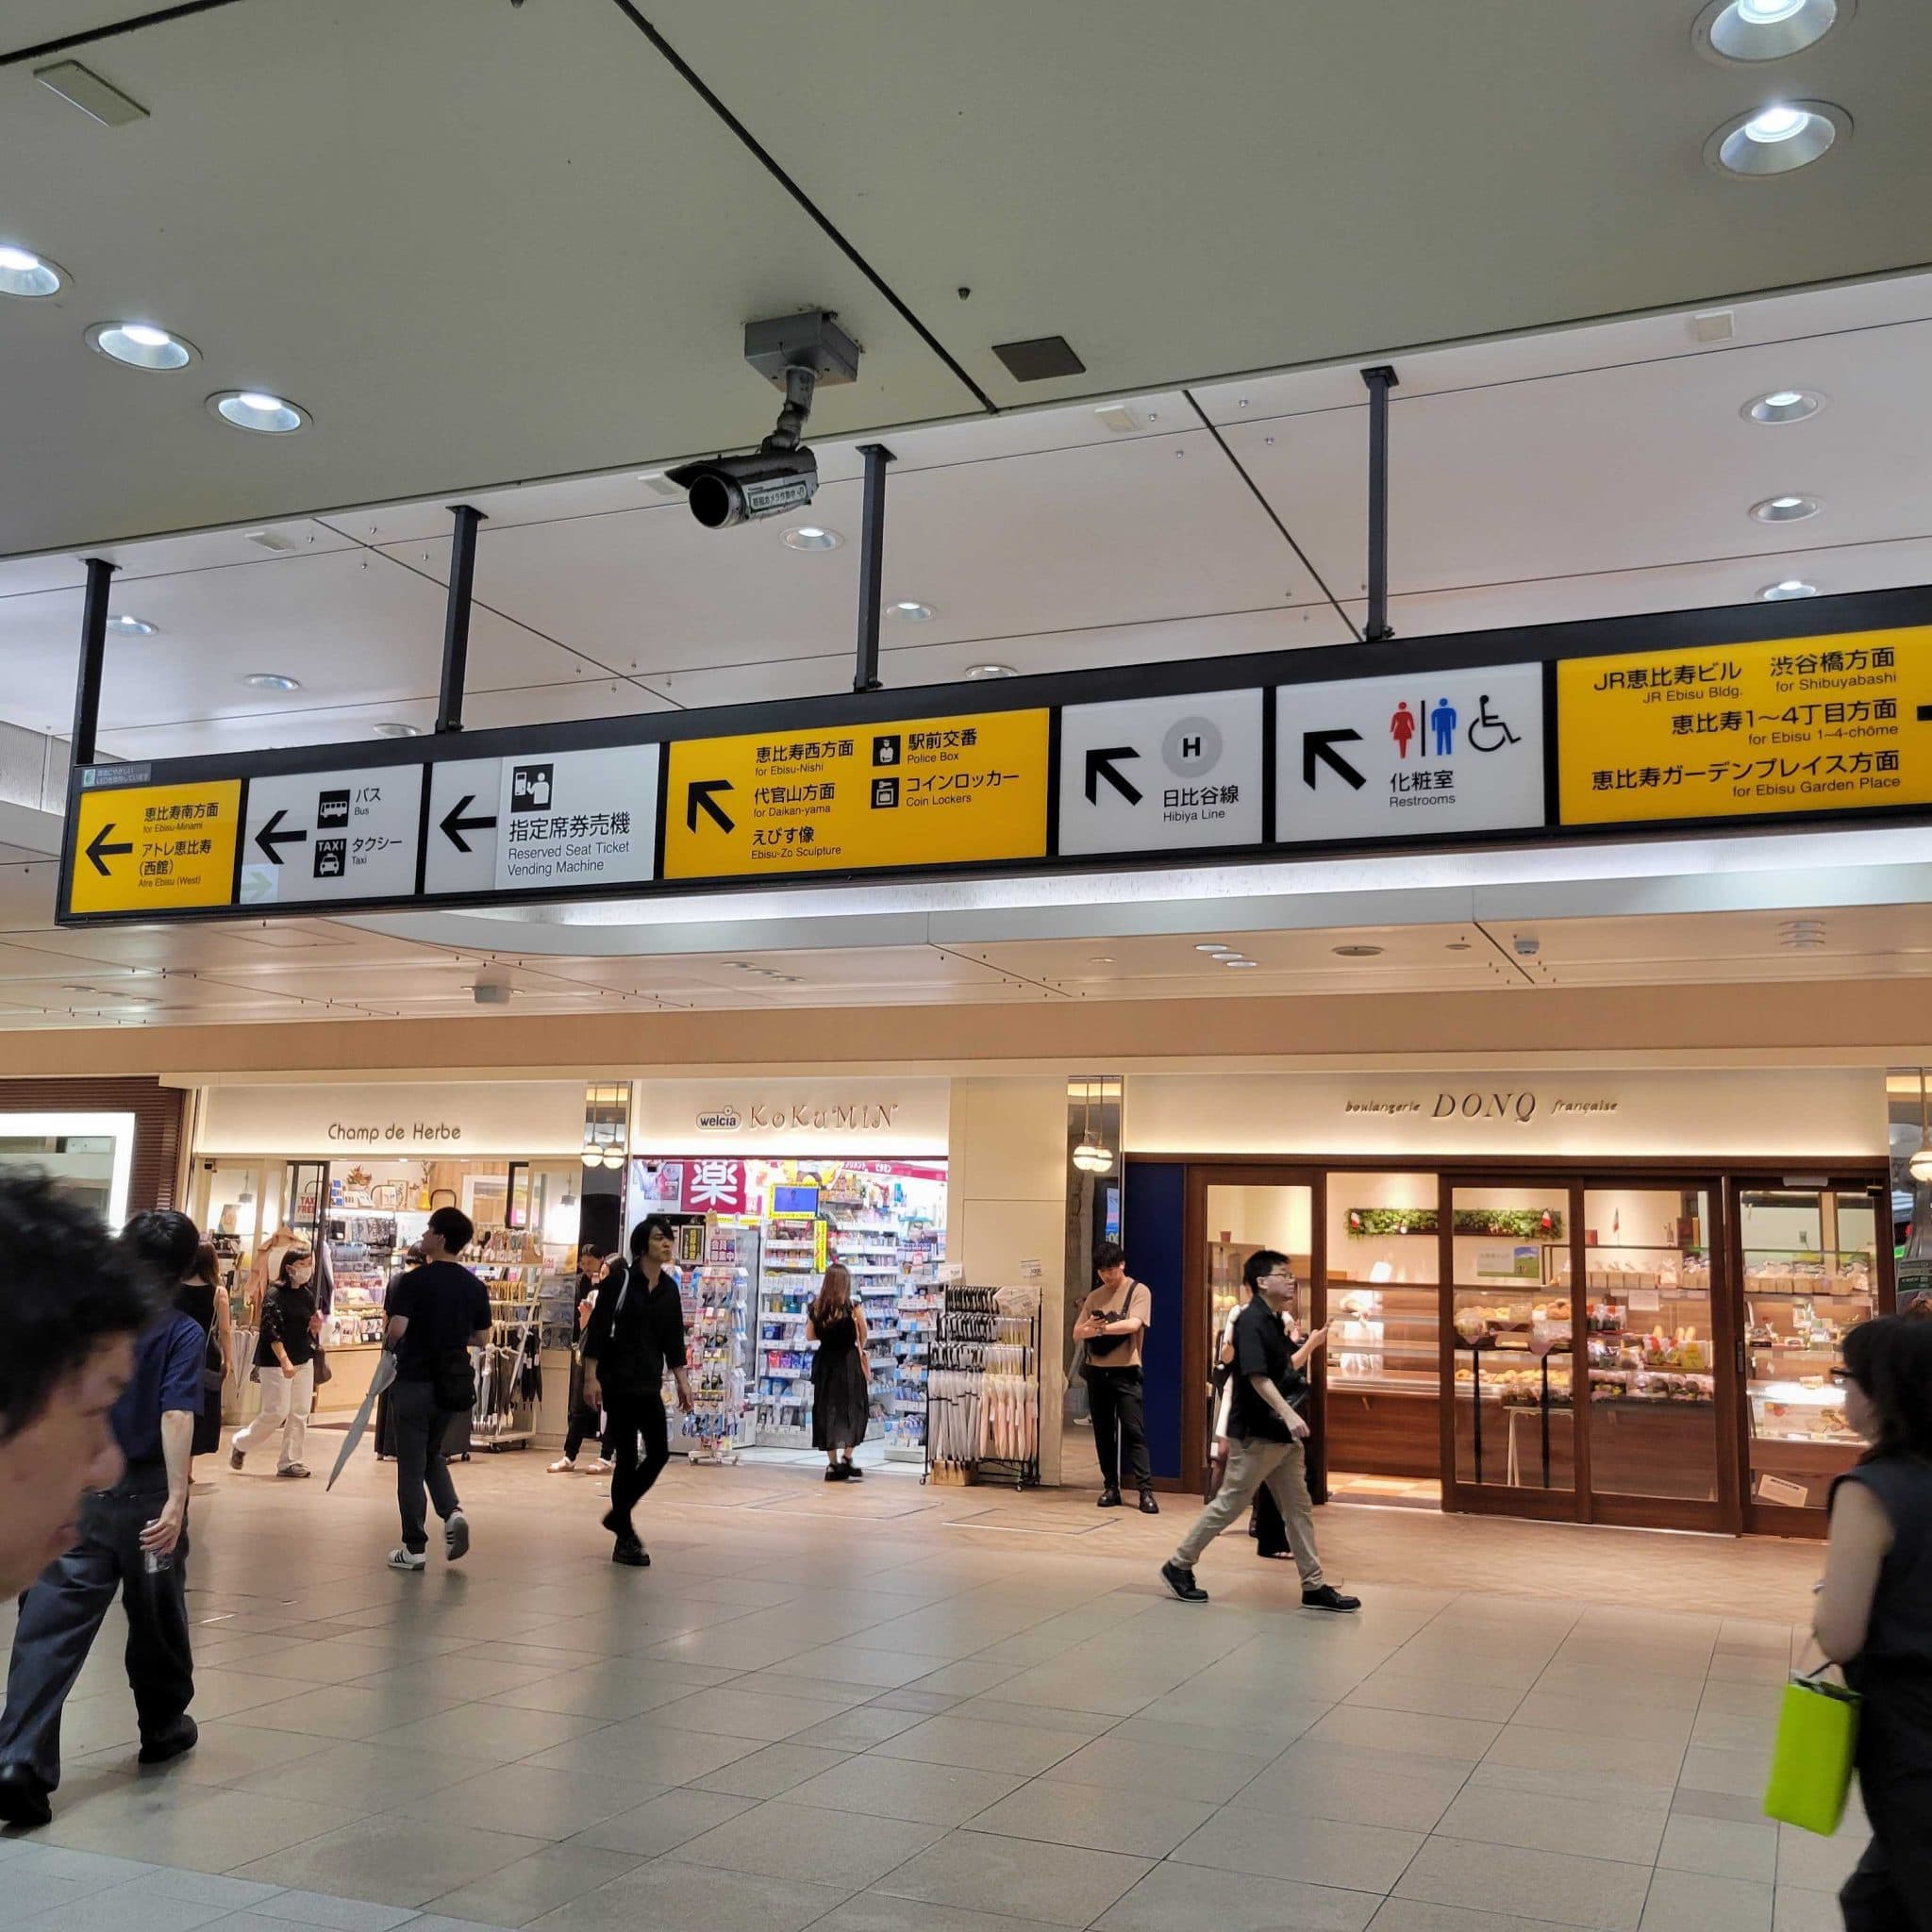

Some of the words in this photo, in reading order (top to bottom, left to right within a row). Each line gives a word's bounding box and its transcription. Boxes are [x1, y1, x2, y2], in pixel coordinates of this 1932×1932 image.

[1771, 646, 1895, 677] 渋谷橋方面
[1593, 661, 1741, 691] JR恵比寿ビル
[1775, 679, 1794, 691] for
[1799, 673, 1896, 692] Shibuyabashi
[1642, 692, 1661, 704] JR
[1667, 689, 1704, 702] Ebisu
[1708, 686, 1743, 700] Bldg.
[908, 728, 976, 752] 駅前交番
[1748, 733, 1767, 745] for
[1772, 730, 1811, 743] Ebisu
[755, 739, 855, 763] 恵比寿西方面
[907, 754, 936, 763] Police
[940, 751, 959, 762] Box
[1182, 737, 1200, 758] H
[755, 767, 767, 776] for
[770, 762, 824, 774] Ebisu-Nishi
[1591, 749, 1900, 791] 恵比寿ガーデンプレイス方面
[906, 769, 1020, 793] コインロッカー
[1390, 770, 1454, 793] 化粧室
[1733, 785, 1752, 798] for
[1757, 781, 1796, 795] Ebisu
[1801, 778, 1855, 793] Garden
[1859, 775, 1900, 790] Place
[356, 788, 381, 803] バス
[754, 782, 836, 806] 代官山方面
[906, 796, 928, 807] Coin
[932, 792, 972, 806] Lockers
[1163, 785, 1239, 809] 日比谷線
[1390, 793, 1456, 808] Restrooms
[144, 802, 219, 822] 恵比寿南方面
[354, 807, 370, 816] Bus
[754, 808, 765, 818] for
[769, 804, 831, 818] Daikan-yama
[1163, 809, 1198, 824] Hibiya
[1202, 808, 1225, 820] Line
[509, 811, 630, 841] 指定席券売機
[752, 826, 814, 845] えびす像
[142, 839, 211, 858] アトレ恵比寿
[318, 841, 344, 852] TAXI
[353, 837, 403, 853] タクシー
[508, 844, 561, 860] Reserved
[566, 842, 591, 857] Seat
[595, 841, 629, 854] Ticket
[751, 848, 793, 859] Ebisu-Zo
[796, 845, 842, 858] Sculpture
[352, 856, 367, 865] Taxi
[508, 862, 552, 876] Vending
[556, 858, 604, 873] Machine
[1345, 1101, 1421, 1113] boulangerie
[1431, 1092, 1537, 1123] DONQ
[1551, 1099, 1619, 1114] française
[700, 1115, 736, 1126] welcia
[328, 1124, 379, 1144] Champ
[384, 1124, 405, 1140] de
[413, 1123, 461, 1140] Herbe
[690, 1160, 738, 1207] 薬
